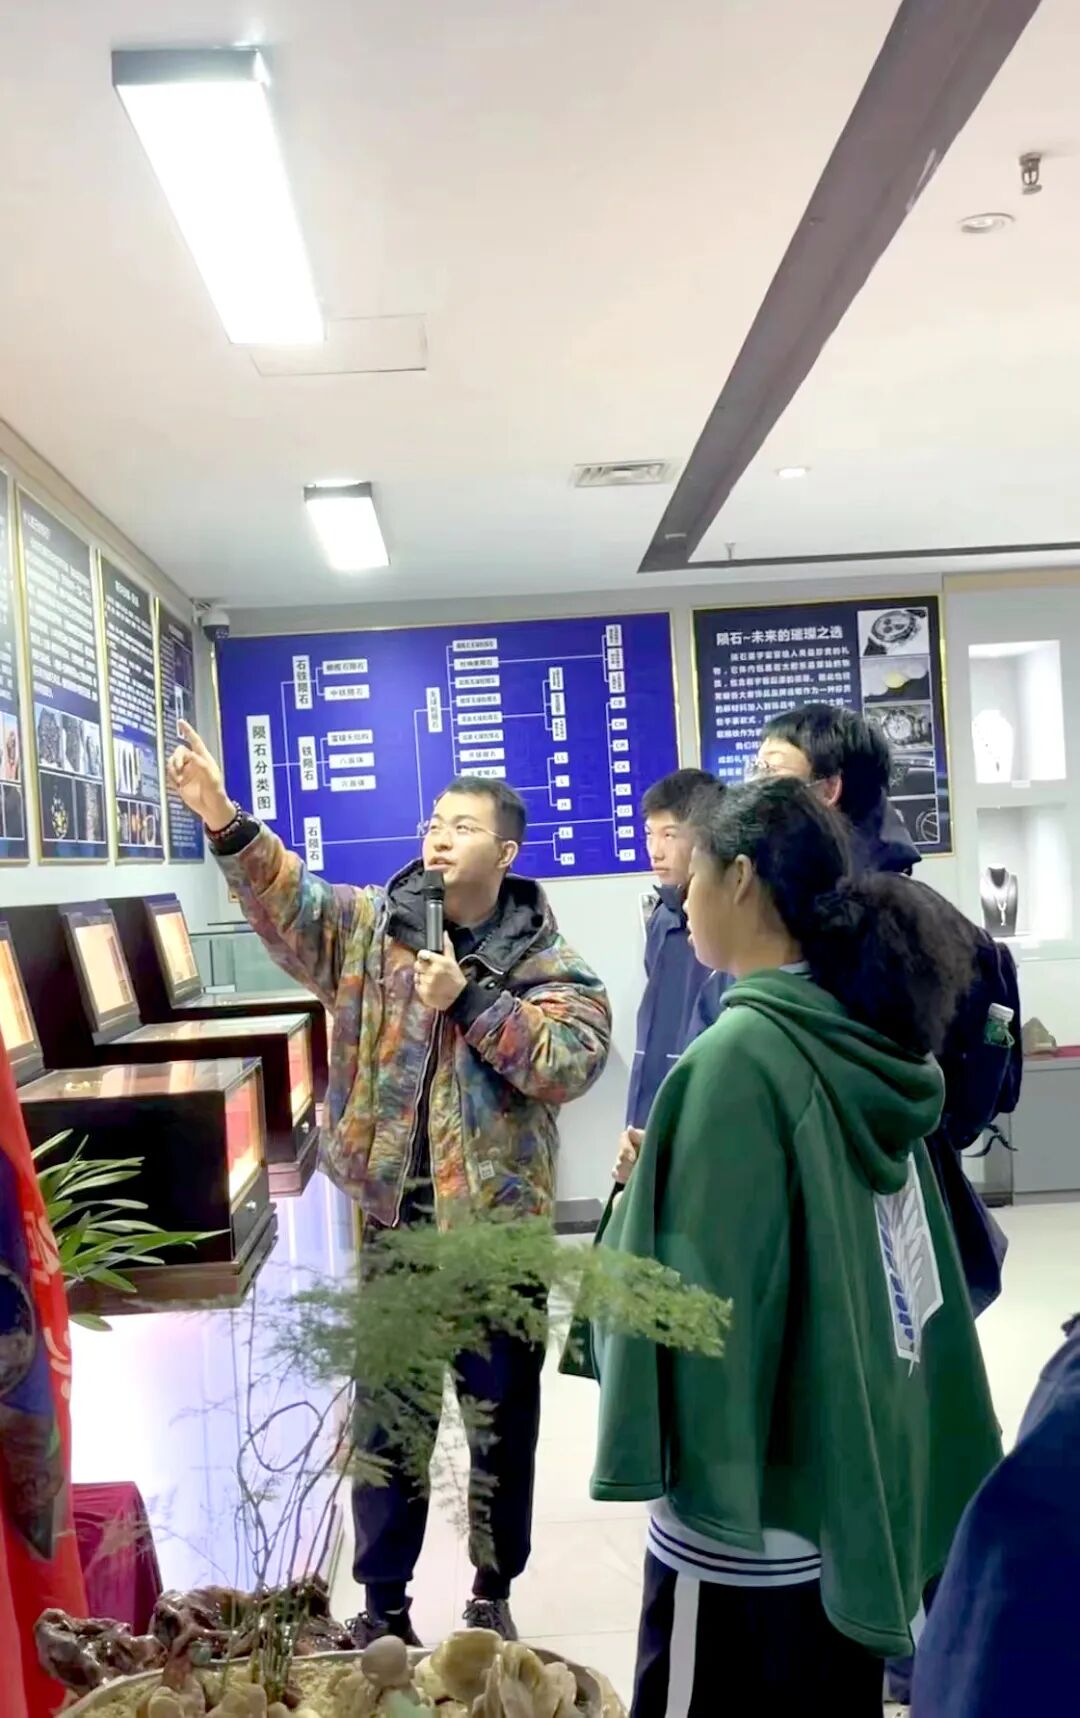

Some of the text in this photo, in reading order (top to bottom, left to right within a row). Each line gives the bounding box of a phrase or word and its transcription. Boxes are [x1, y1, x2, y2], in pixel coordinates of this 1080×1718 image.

[716, 625, 843, 646] 陨石~未来的璀璨之选
[296, 660, 310, 704] 石铁陨石
[252, 725, 272, 809] 陨石分类图
[301, 747, 315, 781] 铁陨石
[307, 827, 320, 860] 石陨石
